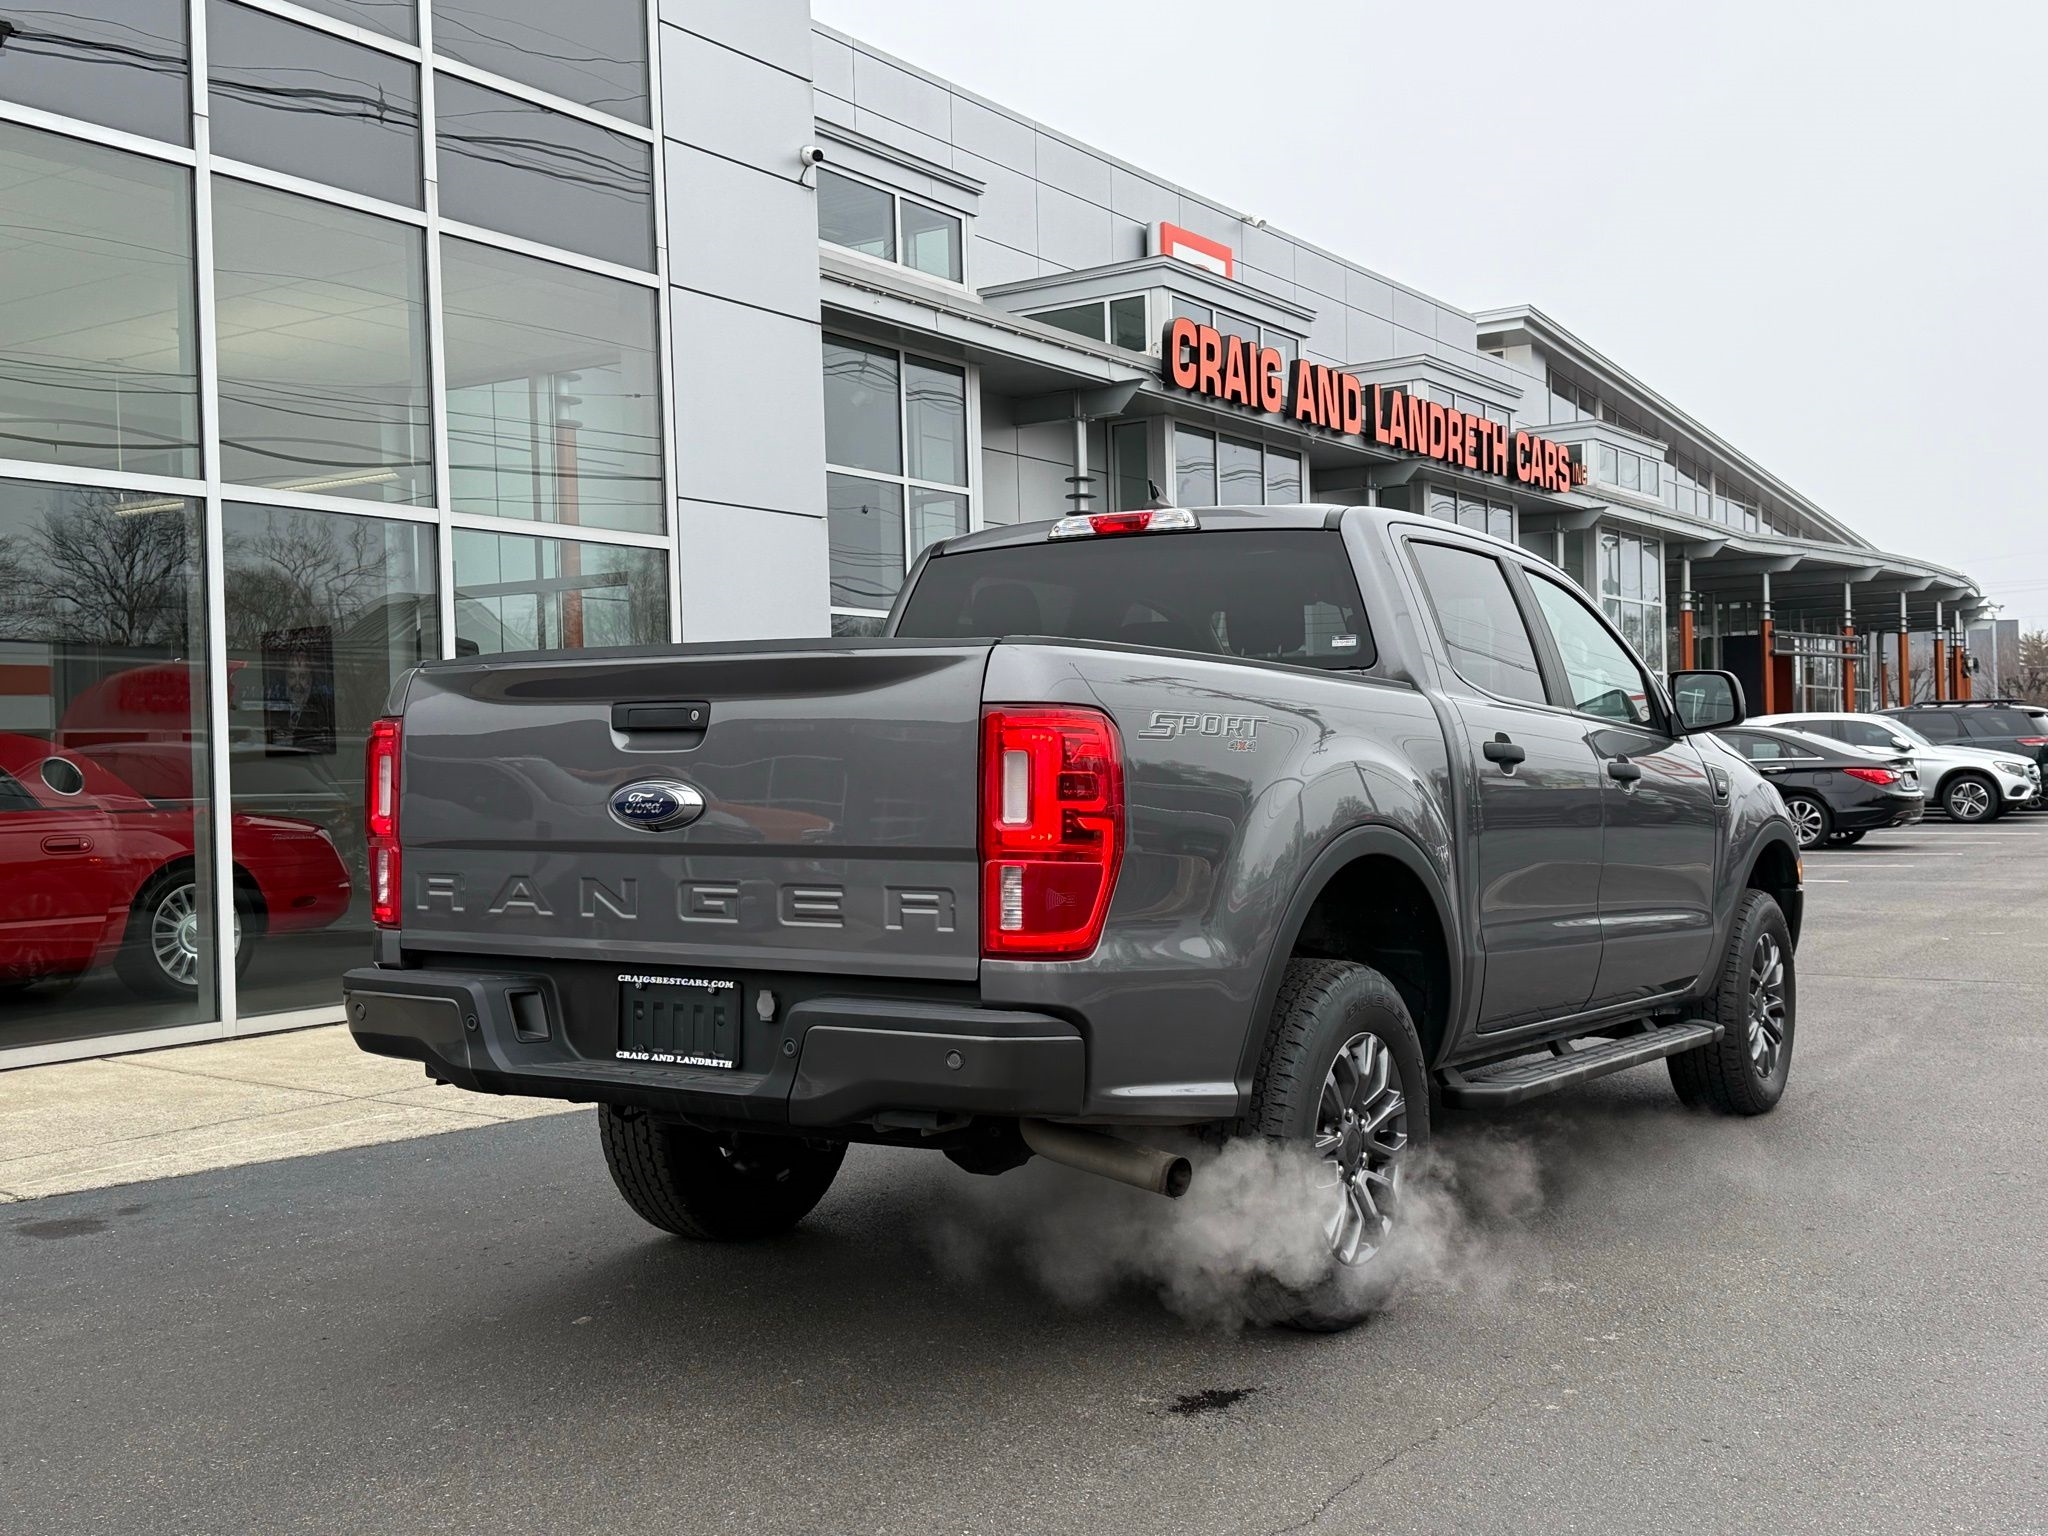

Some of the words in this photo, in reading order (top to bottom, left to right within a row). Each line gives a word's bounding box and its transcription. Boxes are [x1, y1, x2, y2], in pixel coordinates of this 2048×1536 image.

[1168, 317, 1282, 413] CRAIG
[1293, 358, 1362, 435] AND
[1370, 383, 1508, 477] LANDRETH
[1514, 430, 1571, 493] CARS
[1137, 710, 1270, 741] SPORT
[624, 792, 664, 814] Ford
[416, 871, 956, 933] RANGER
[617, 974, 735, 989] CRAIGSBESTCARS.COM
[615, 1050, 650, 1061] CRAIG
[651, 1053, 675, 1063] AND
[676, 1055, 733, 1069] LANDRETH
